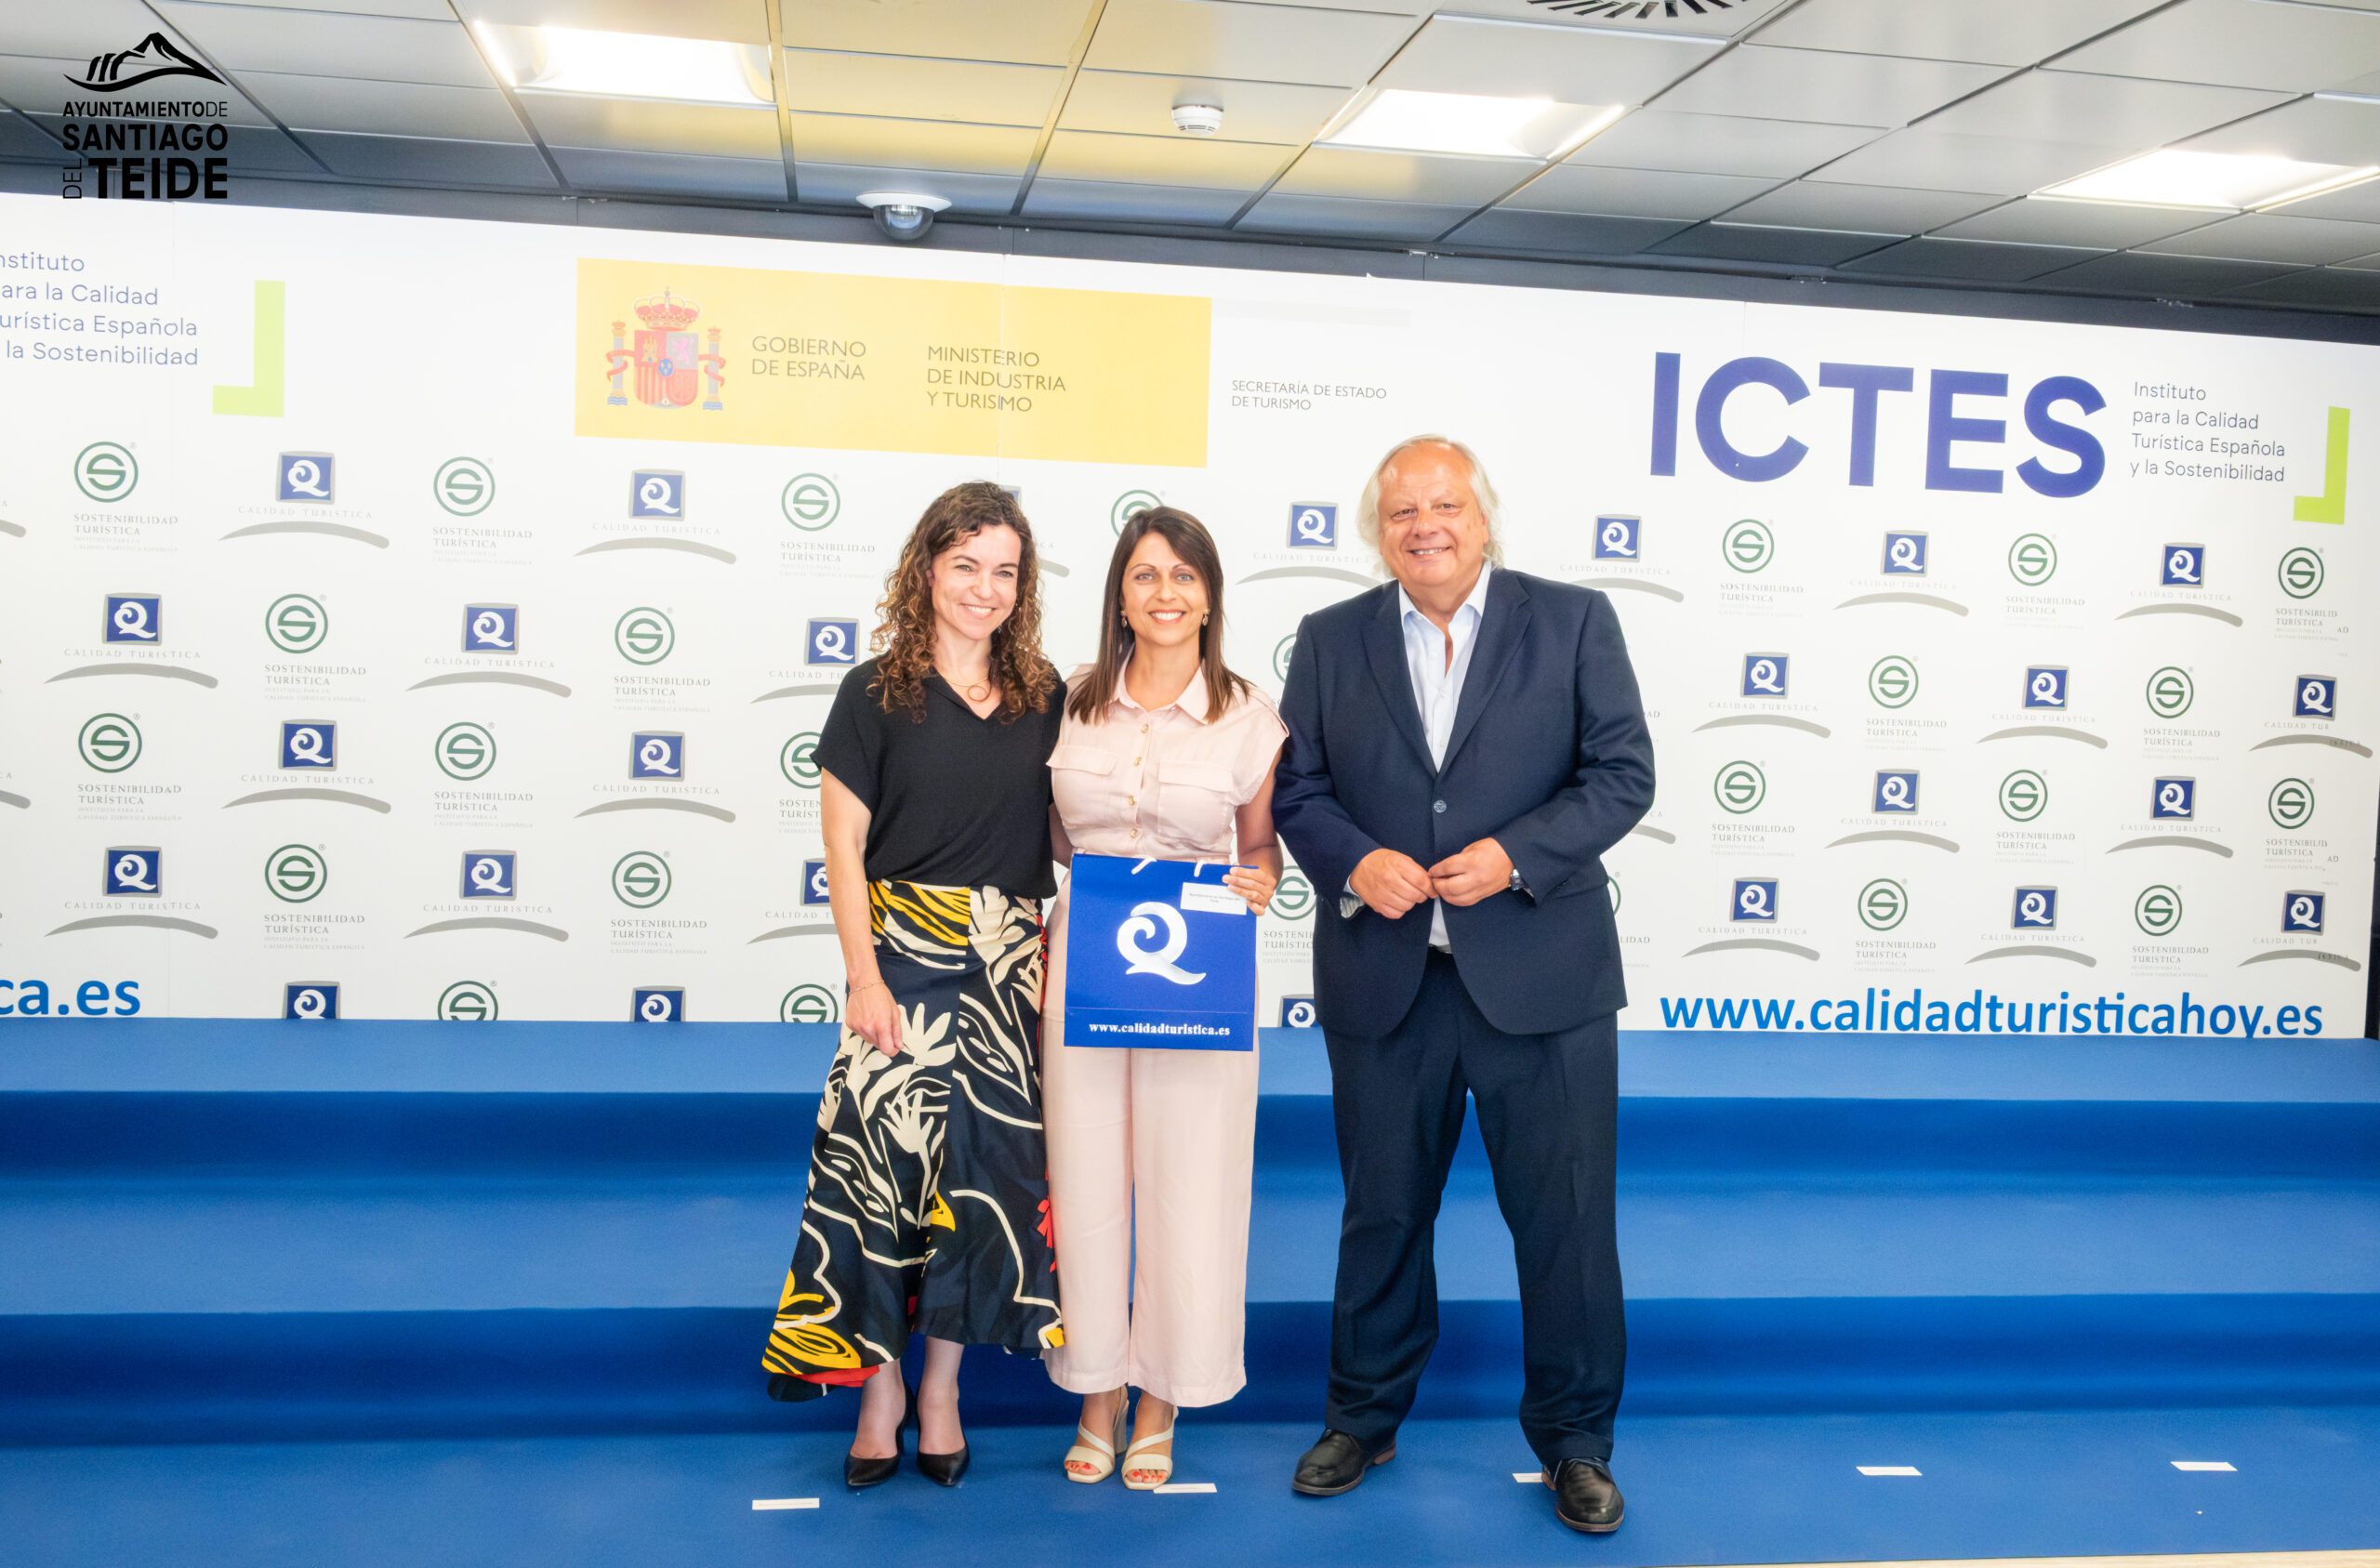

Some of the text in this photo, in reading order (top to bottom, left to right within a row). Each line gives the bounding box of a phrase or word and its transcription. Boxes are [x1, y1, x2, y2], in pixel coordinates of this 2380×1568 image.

[0, 251, 85, 271] nstituto
[1, 282, 158, 306] ara la Calidad
[0, 311, 197, 339] urística Española
[7, 340, 198, 366] la Sostenibilidad
[751, 336, 867, 358] GOBIERNO
[927, 345, 1040, 368] MINISTERIO
[751, 358, 866, 381] DE ESPAÑA
[927, 368, 1066, 392] DE INDUSTRIA
[1231, 379, 1388, 400] SECRETARÍA DE ESTADO
[2134, 381, 2207, 401] Instituto
[926, 390, 1033, 413] Y TURISMO
[1231, 395, 1312, 411] DE TURISMO
[1650, 350, 2108, 500] ICTES
[2133, 409, 2259, 430] para la Calidad
[2132, 432, 2286, 458] Turística Española
[2129, 458, 2285, 483] y la Sostenibilidad
[74, 512, 178, 526] SOSTENIBILIDAD
[433, 526, 535, 539] SOSTENIBILIDAD
[781, 540, 875, 554] SOSTENIBILIDAD
[1720, 582, 1804, 594] SOSTENIBILIDAD
[2006, 594, 2085, 606] SOSTENIBILIDAD
[64, 649, 121, 657] CALIDAD
[425, 657, 480, 665] CALIDAD
[265, 664, 366, 676] SOSTENIBILIDAD
[770, 670, 821, 679] CALIDAD
[615, 676, 710, 687] SOSTENIBILIDAD
[1867, 718, 1947, 729] SOSTENIBILIDAD
[2144, 727, 2220, 738] SOSTENIBILIDAD
[78, 784, 181, 795] SOSTENIBILIDAD
[593, 784, 646, 793] CALIDAD
[434, 790, 533, 802] SOSTENIBILIDAD
[779, 809, 821, 819] TURÍST
[1711, 824, 1795, 834] SOSTENIBILIDAD
[1996, 831, 2075, 841] SOSTENIBILIDAD
[65, 902, 121, 910] CALIDAD
[264, 913, 364, 923] SOSTENIBILIDAD
[765, 911, 817, 919] CALIDAD
[611, 918, 707, 929] SOSTENIBILIDAD
[1116, 901, 1207, 986] Q
[1264, 939, 1313, 949] TURÍSTIC
[1856, 940, 1936, 950] SOSTENIBILIDAD
[2132, 944, 2209, 955] SOSTENIBILIDAD
[0, 979, 141, 1017] ca.es
[1659, 987, 2324, 1038] www.calidadturisticahoy.es
[1089, 1022, 1231, 1036] www.calidadturistica.es
